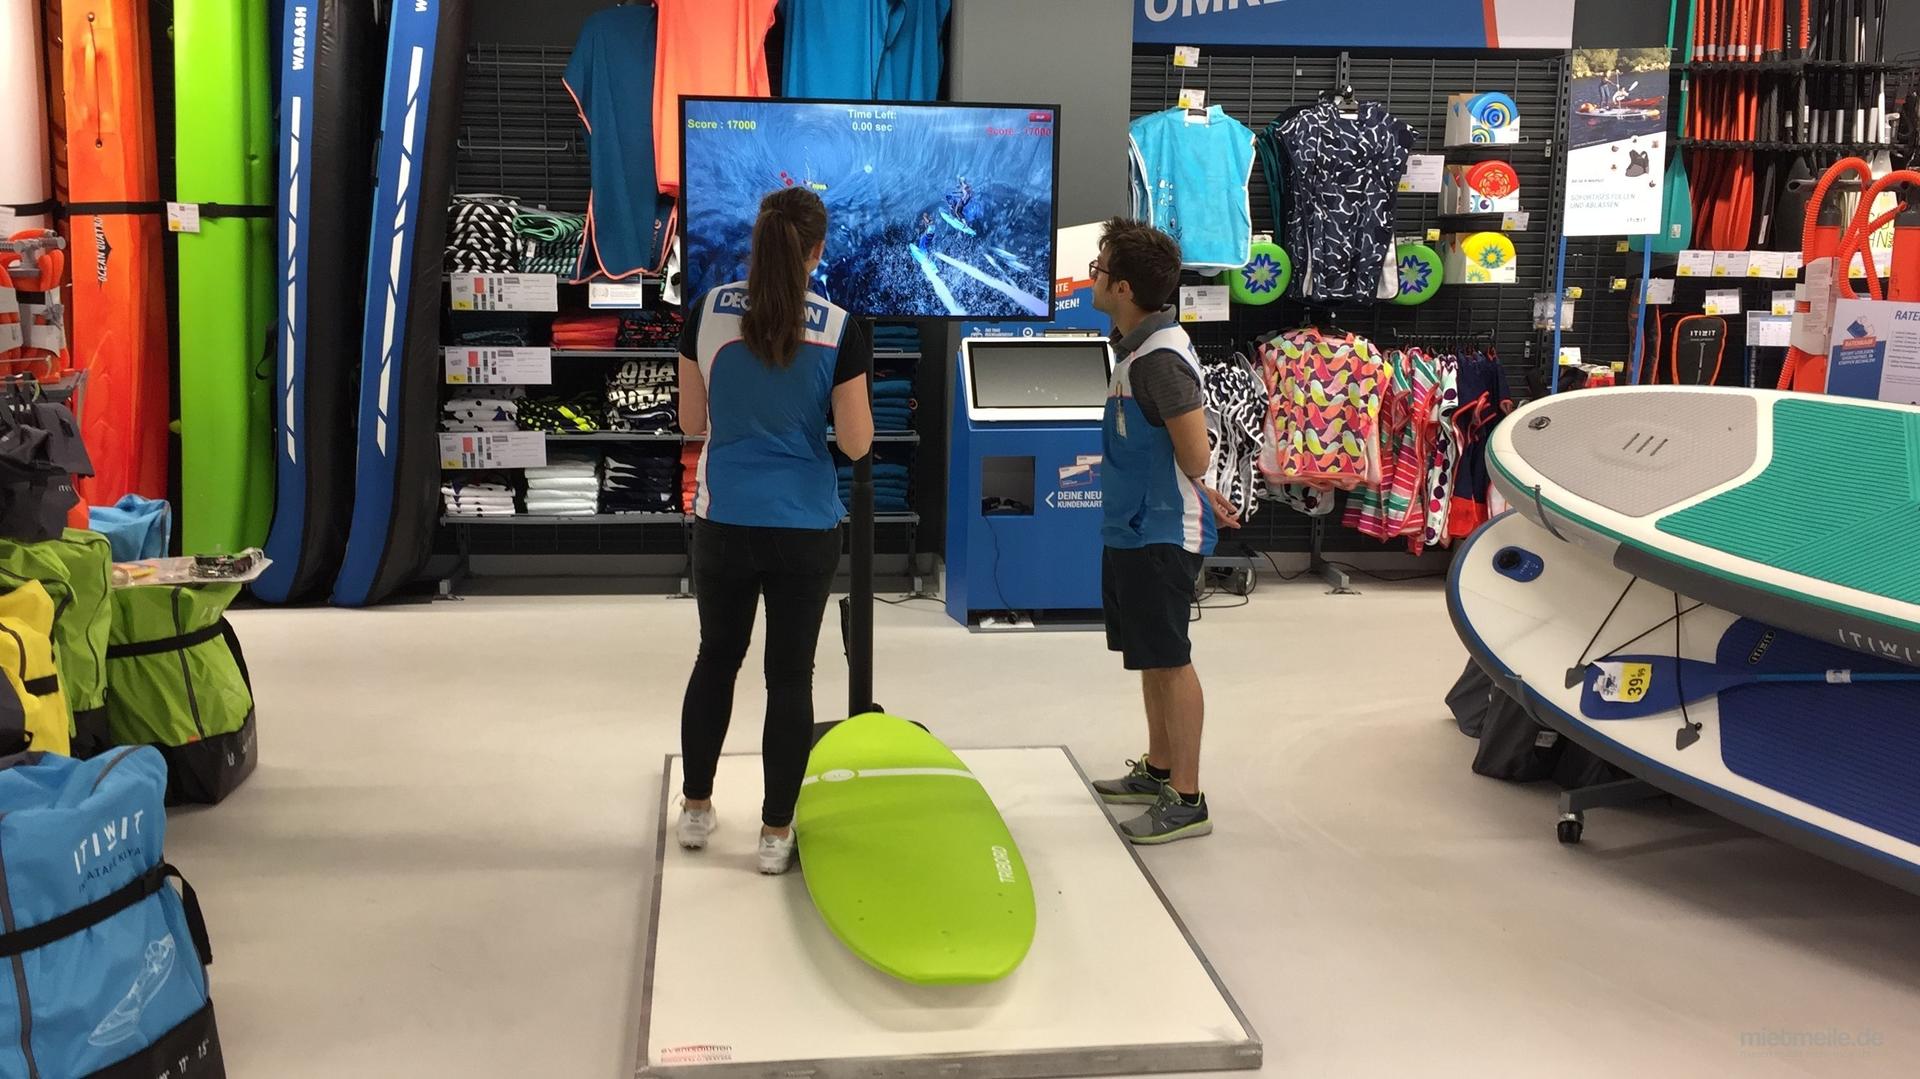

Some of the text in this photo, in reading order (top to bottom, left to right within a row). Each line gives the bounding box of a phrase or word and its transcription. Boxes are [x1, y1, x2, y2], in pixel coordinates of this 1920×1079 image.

[292, 6, 307, 71] WABASH
[848, 109, 897, 120] Time Left:
[687, 119, 718, 130] Score
[726, 120, 757, 130] 17000
[852, 121, 893, 132] 0.00 sec
[96, 252, 108, 282] OCEAN
[1057, 490, 1102, 500] DEINE NEU
[1057, 500, 1103, 508] KUNDENKART
[1838, 628, 1920, 664] ITIWI
